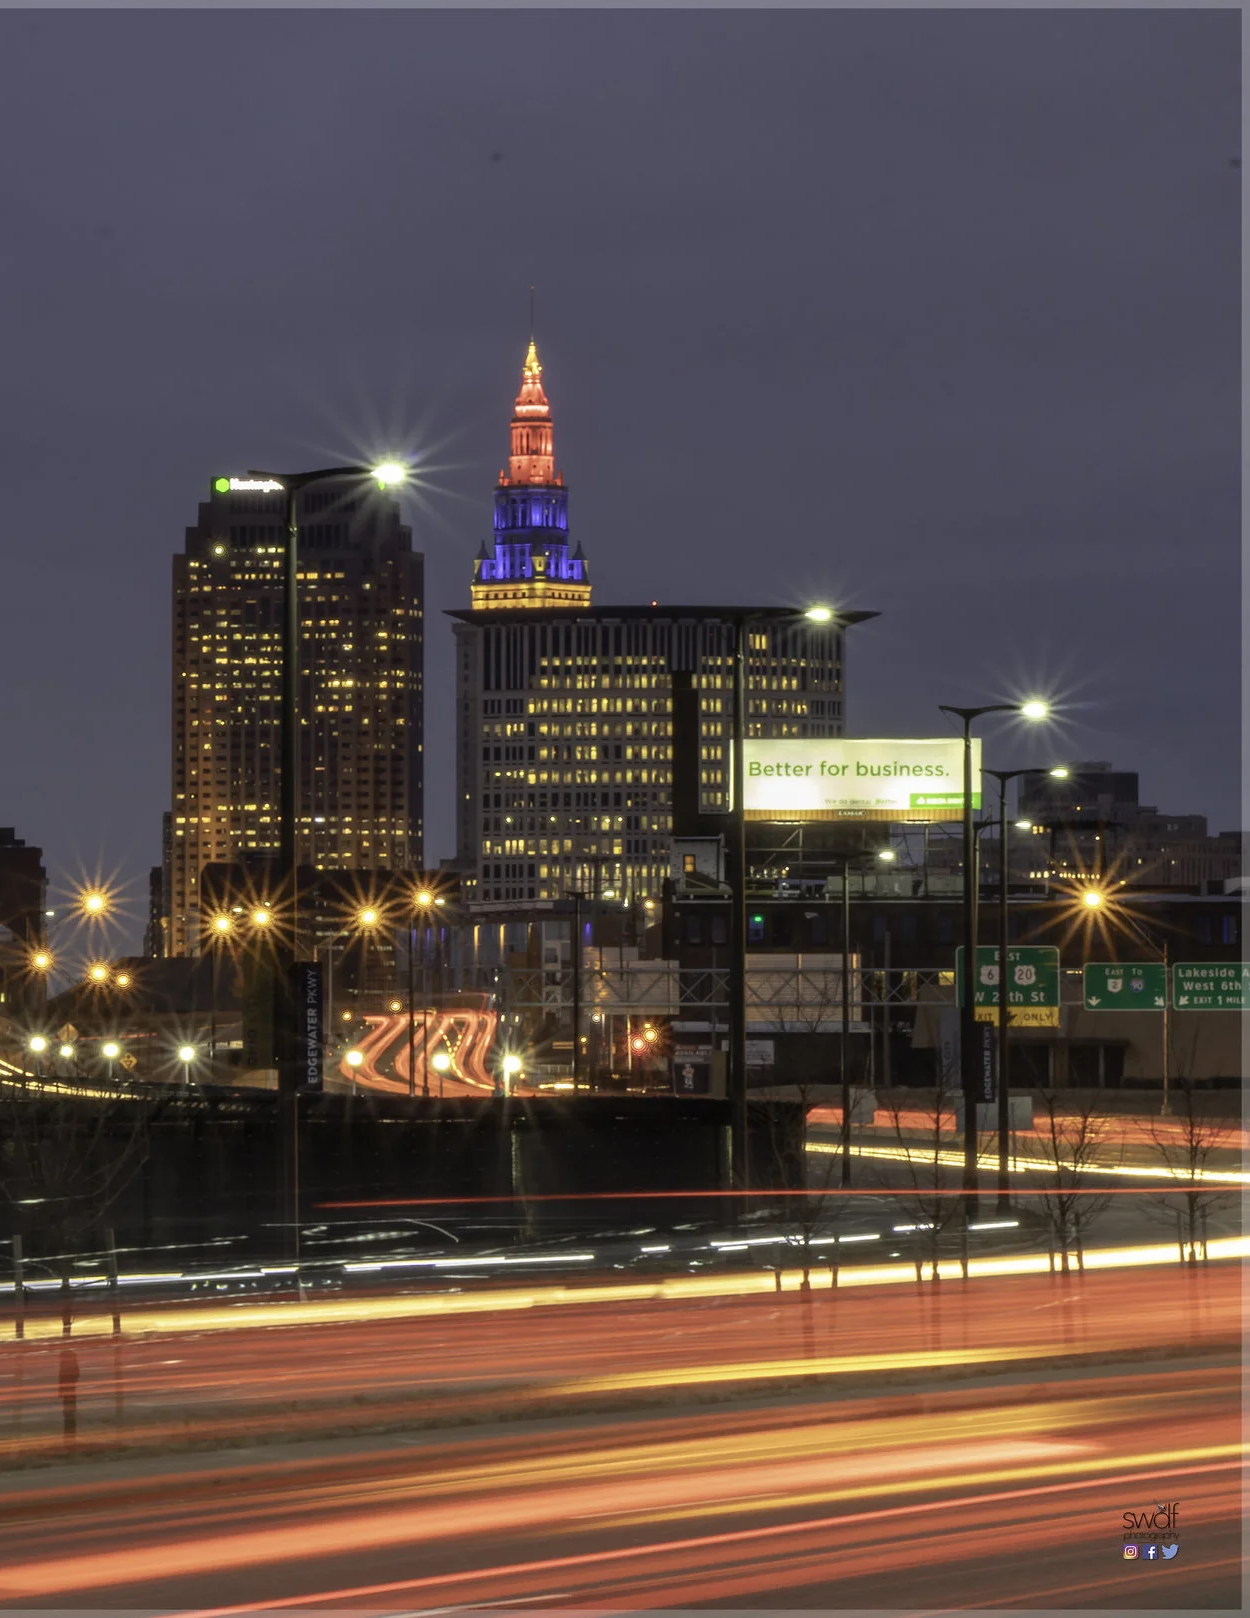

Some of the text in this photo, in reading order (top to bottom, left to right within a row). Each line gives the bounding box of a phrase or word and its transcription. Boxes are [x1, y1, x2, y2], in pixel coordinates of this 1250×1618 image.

[748, 760, 950, 777] Better for business.
[994, 951, 1021, 961] EST
[987, 968, 1032, 980] 6 20
[1105, 968, 1124, 976] EAST
[1178, 968, 1235, 978] Lakeside
[1111, 981, 1118, 990] 2
[1183, 981, 1215, 991] West
[1221, 981, 1242, 991] 6th
[992, 991, 1024, 1002] 2th
[1030, 991, 1045, 1002] St
[1217, 995, 1223, 1005] 1
[975, 1013, 1054, 1021] XIT ONLY
[307, 969, 318, 1084] EDGEWATER PKWY
[984, 1050, 992, 1099] EDGEWATER
